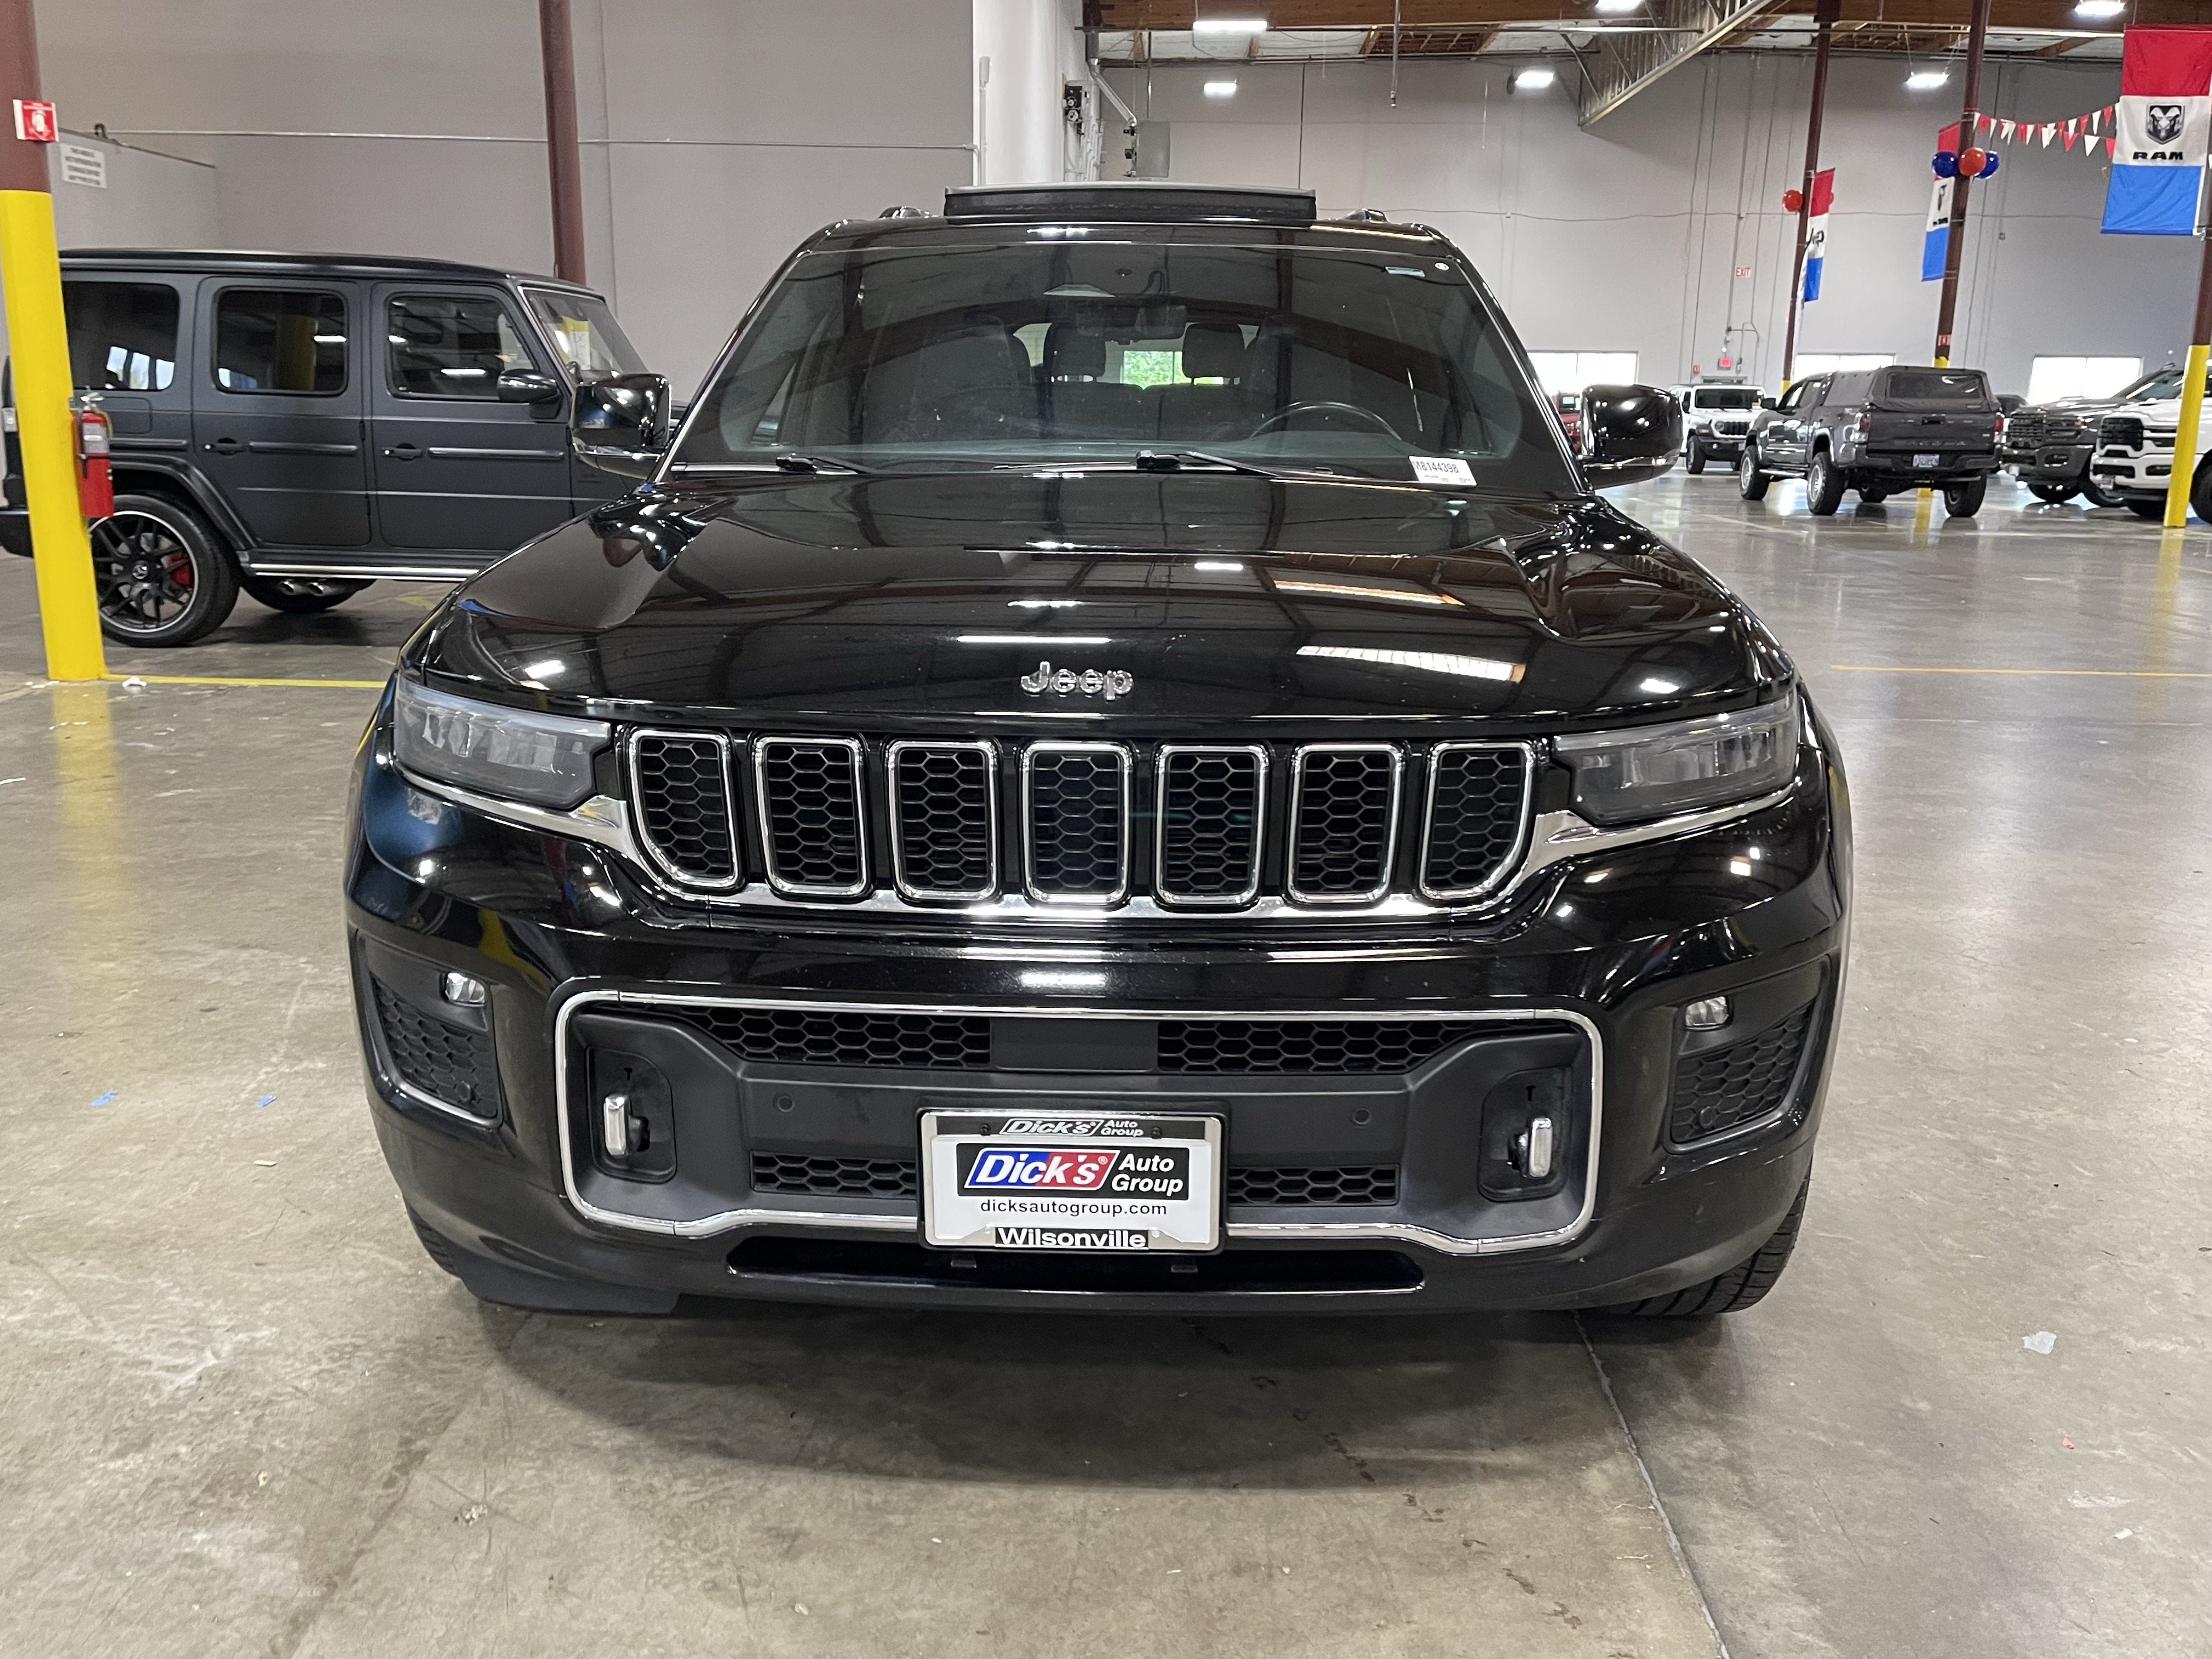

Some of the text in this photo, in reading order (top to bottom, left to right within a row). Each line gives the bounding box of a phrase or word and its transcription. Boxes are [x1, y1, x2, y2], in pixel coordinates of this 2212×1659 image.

[2133, 151, 2183, 160] RAM
[1021, 661, 1134, 701] Jeep
[1007, 1120, 1138, 1134] Dick's Auto
[1101, 1127, 1144, 1137] Group
[975, 1154, 1175, 1185] Dick's Auto
[1111, 1174, 1183, 1197] Group
[980, 1200, 1167, 1216] dicksautogroup.com
[997, 1227, 1147, 1248] Wilsonville
